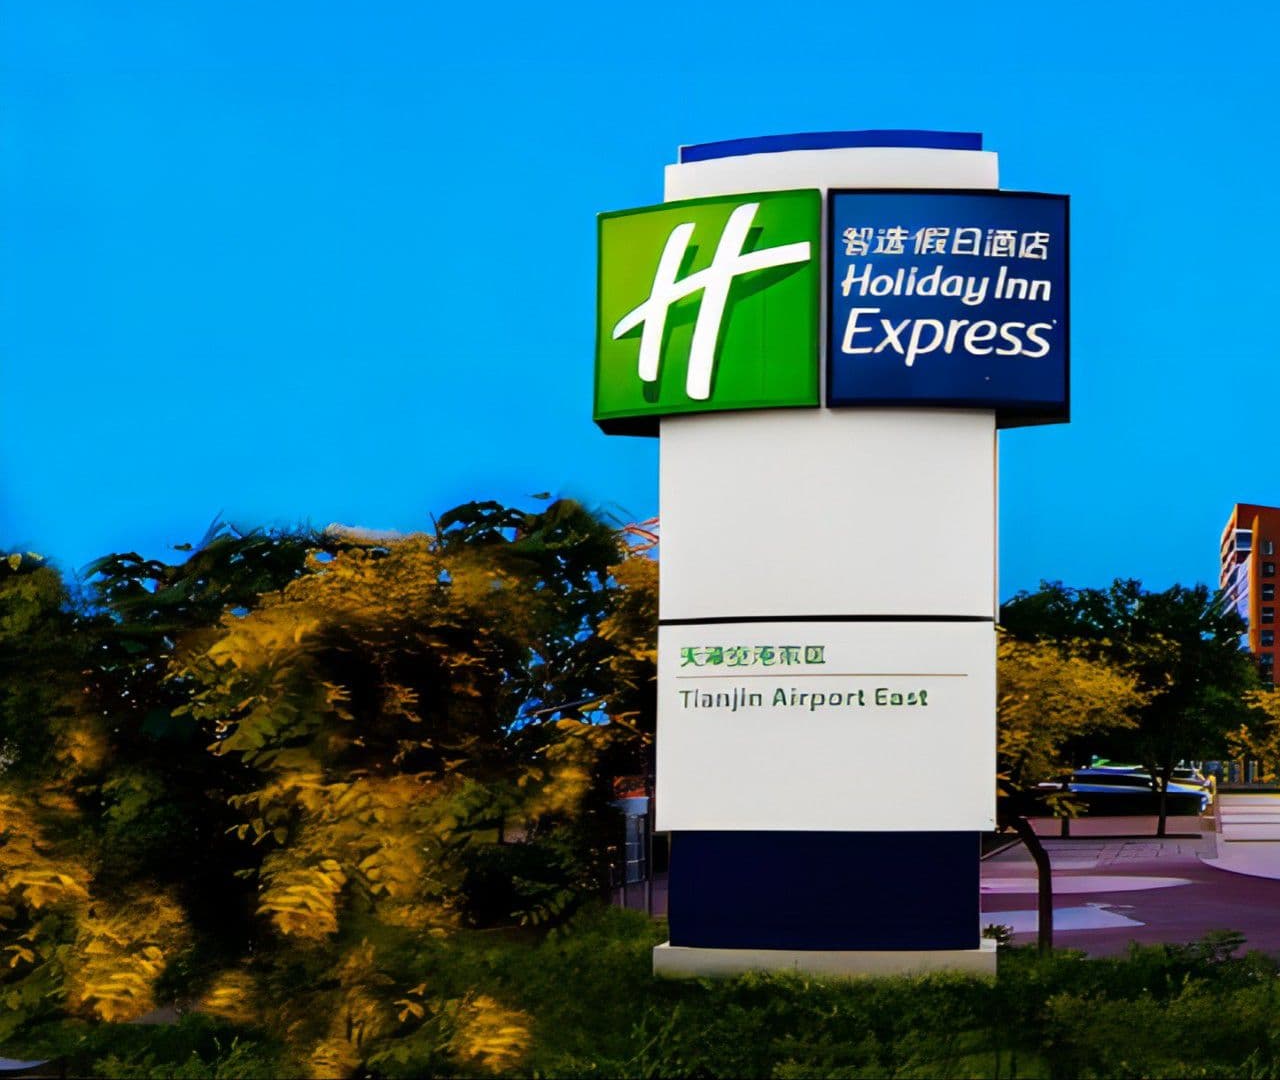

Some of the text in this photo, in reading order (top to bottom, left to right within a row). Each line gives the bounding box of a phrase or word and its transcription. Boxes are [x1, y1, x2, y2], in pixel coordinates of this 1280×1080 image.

[612, 202, 811, 400] H
[841, 263, 1051, 306] Holiday Inn
[841, 307, 1053, 367] Express
[679, 687, 928, 712] Tianjin Airport East
